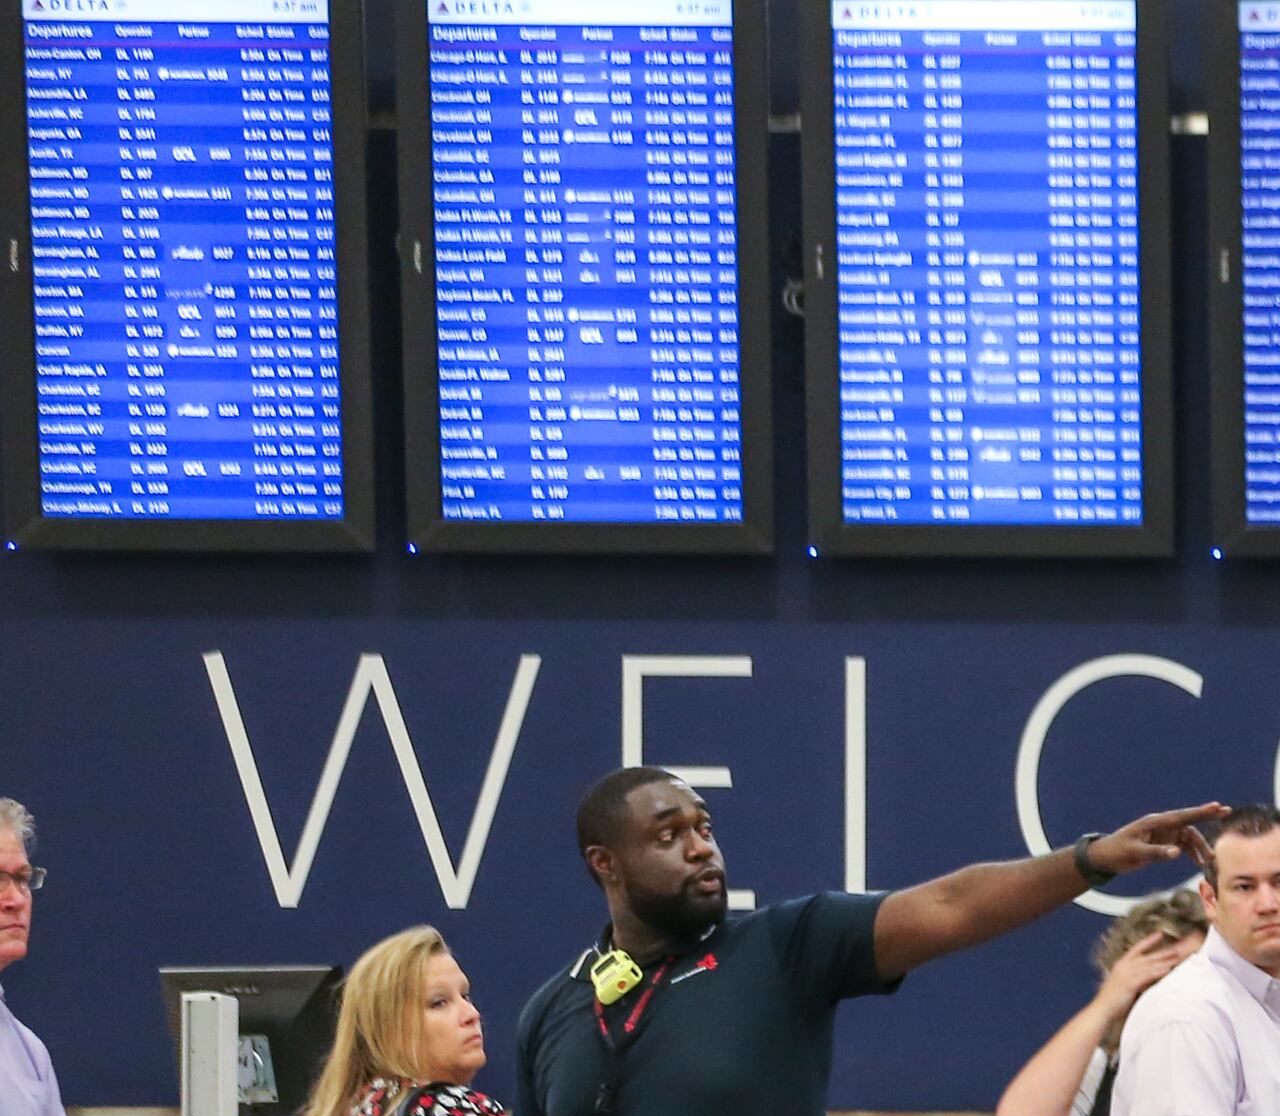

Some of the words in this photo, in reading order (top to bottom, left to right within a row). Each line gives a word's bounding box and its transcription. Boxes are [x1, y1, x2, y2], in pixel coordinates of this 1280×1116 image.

[51, 0, 108, 11] DELTA
[456, 2, 514, 14] DELTA
[29, 25, 93, 39] Departures
[434, 28, 498, 43] Departures
[838, 32, 902, 48] Departures
[268, 51, 282, 61] On
[283, 51, 303, 61] Time
[268, 70, 282, 80] On
[284, 70, 304, 80] Time
[269, 90, 283, 100] On
[285, 90, 304, 101] Time
[270, 110, 284, 120] On
[285, 109, 305, 120] Time
[270, 130, 284, 140] On
[286, 130, 305, 140] Time
[271, 149, 285, 160] On
[286, 149, 306, 160] Time
[272, 170, 286, 180] On
[287, 170, 307, 180] Time
